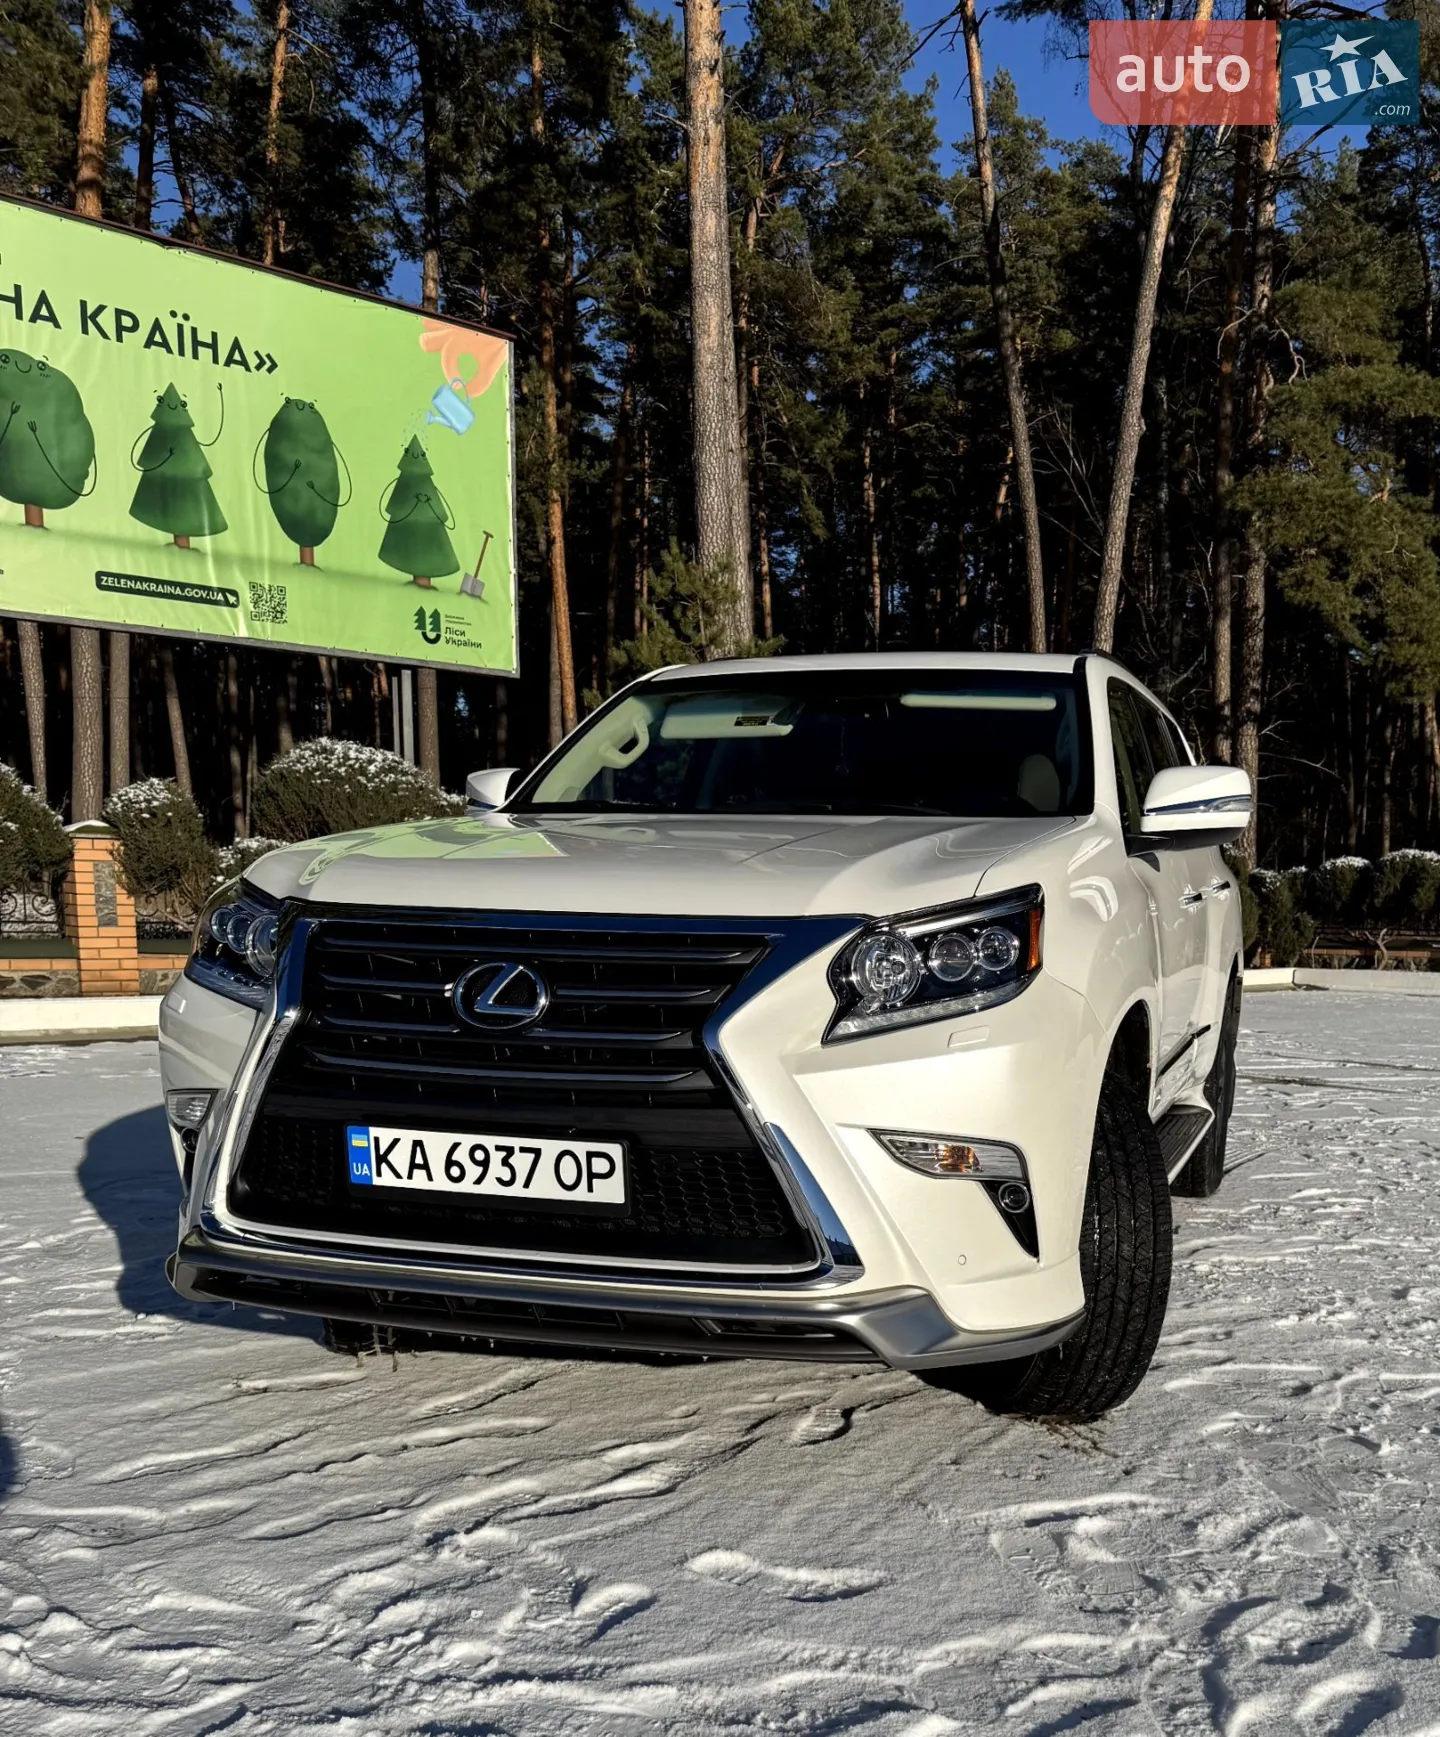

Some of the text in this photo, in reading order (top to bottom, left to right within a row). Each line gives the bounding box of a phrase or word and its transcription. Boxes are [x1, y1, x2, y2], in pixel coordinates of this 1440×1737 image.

[79, 299, 279, 375] КРАЇНА»
[100, 575, 225, 602] ZELENAKRAINA.GOV.UA
[444, 626, 466, 638] Ліси
[352, 1162, 371, 1177] UA
[373, 1136, 434, 1182] KA
[444, 1142, 543, 1190] 6937
